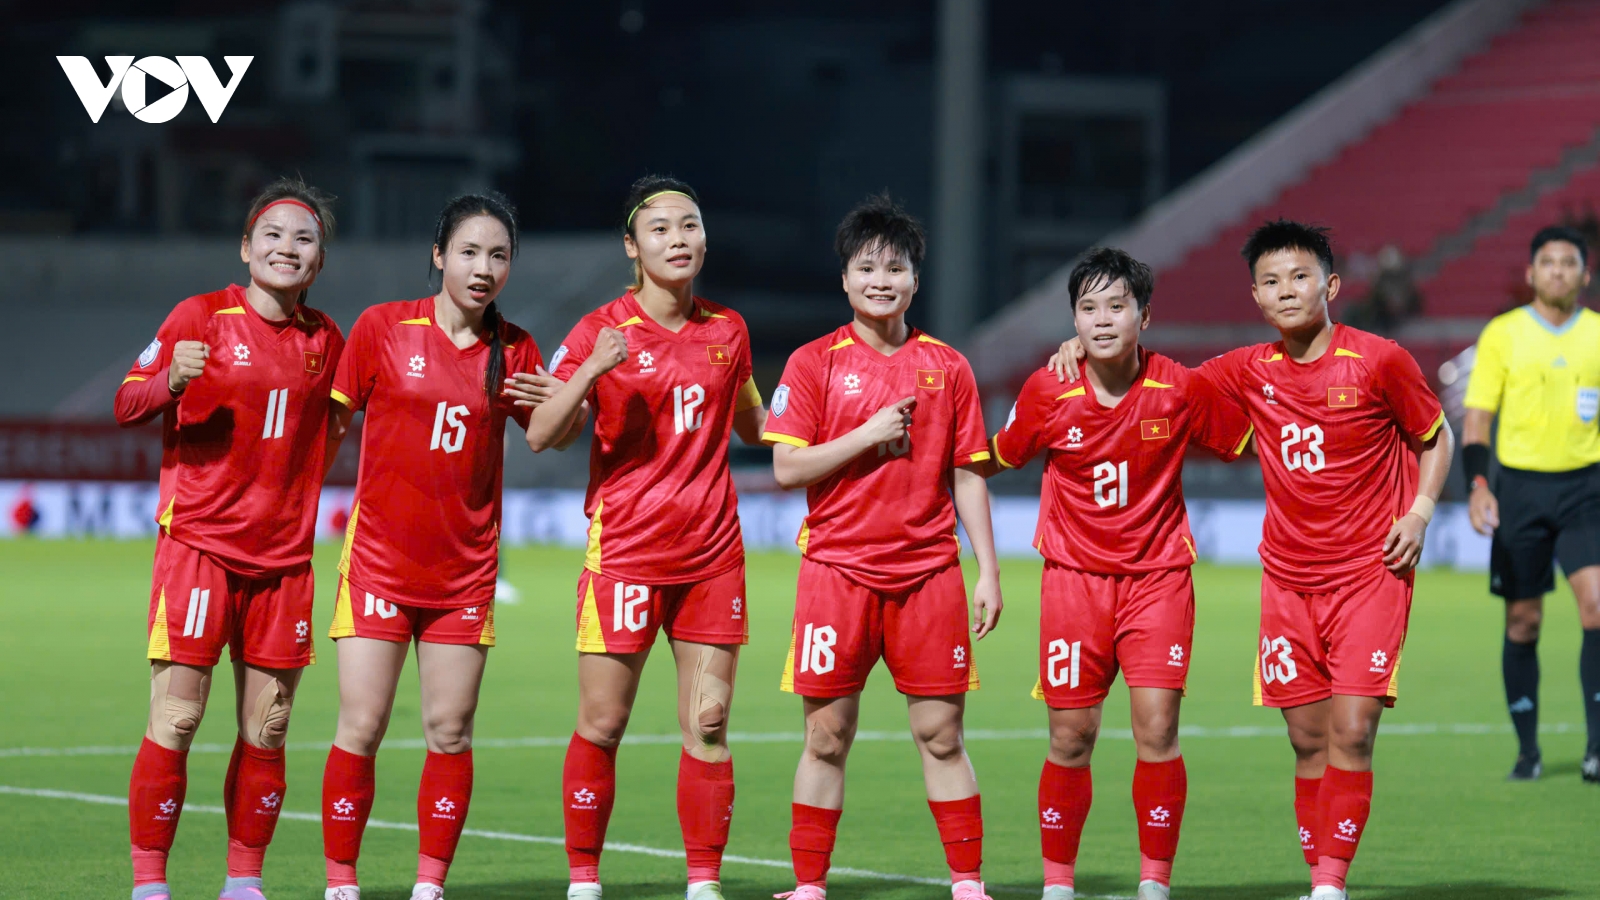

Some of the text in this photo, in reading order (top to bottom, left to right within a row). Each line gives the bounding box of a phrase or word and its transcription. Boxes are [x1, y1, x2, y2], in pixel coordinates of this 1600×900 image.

[262, 387, 289, 440] 11
[430, 401, 471, 454] 15
[673, 382, 706, 436] 12
[1280, 421, 1326, 474] 23
[1093, 460, 1129, 509] 21
[182, 586, 211, 640] 11
[612, 581, 649, 633] 12
[799, 621, 837, 676] 18
[1046, 637, 1081, 690] 21
[1261, 634, 1299, 686] 23
